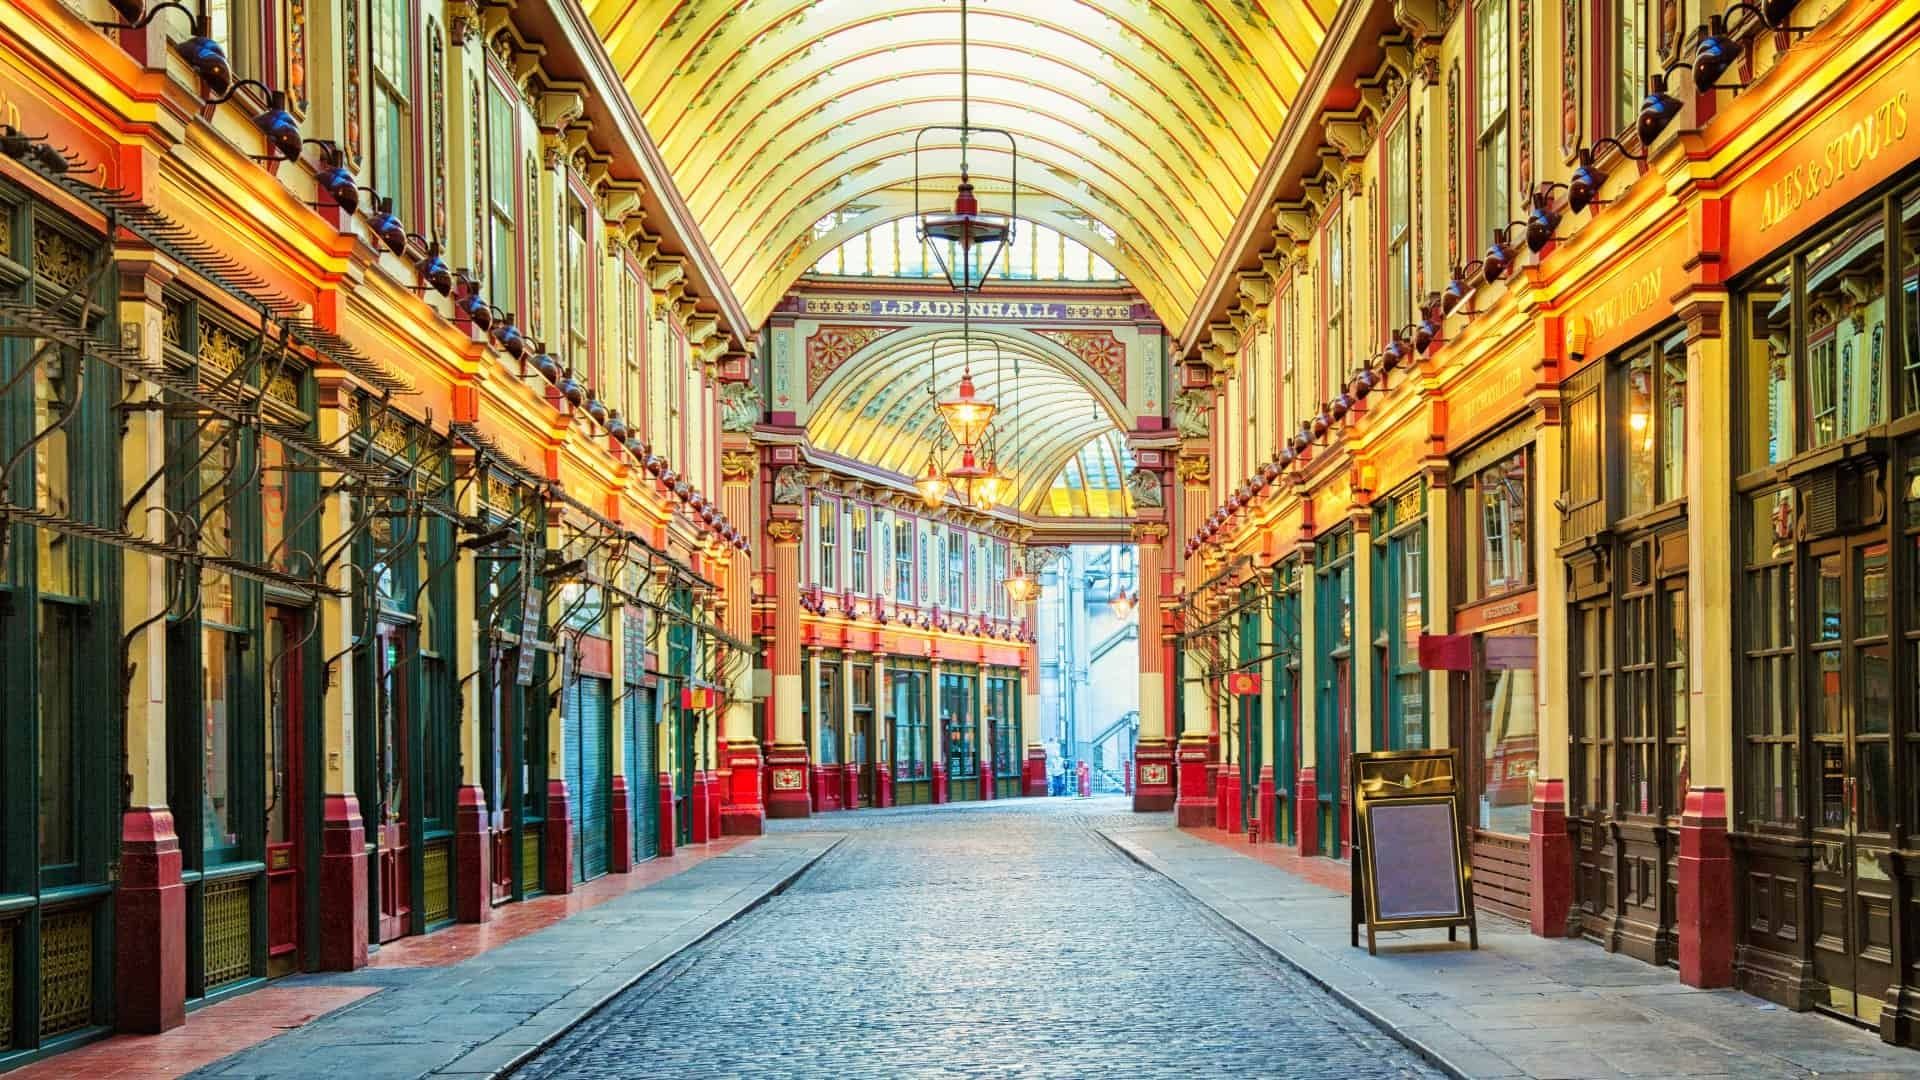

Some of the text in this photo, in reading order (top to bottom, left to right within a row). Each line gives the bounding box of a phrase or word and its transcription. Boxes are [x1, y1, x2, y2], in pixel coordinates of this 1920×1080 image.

[1758, 89, 1909, 233] ALES & STOUTS
[880, 299, 1058, 319] LEADENHALL
